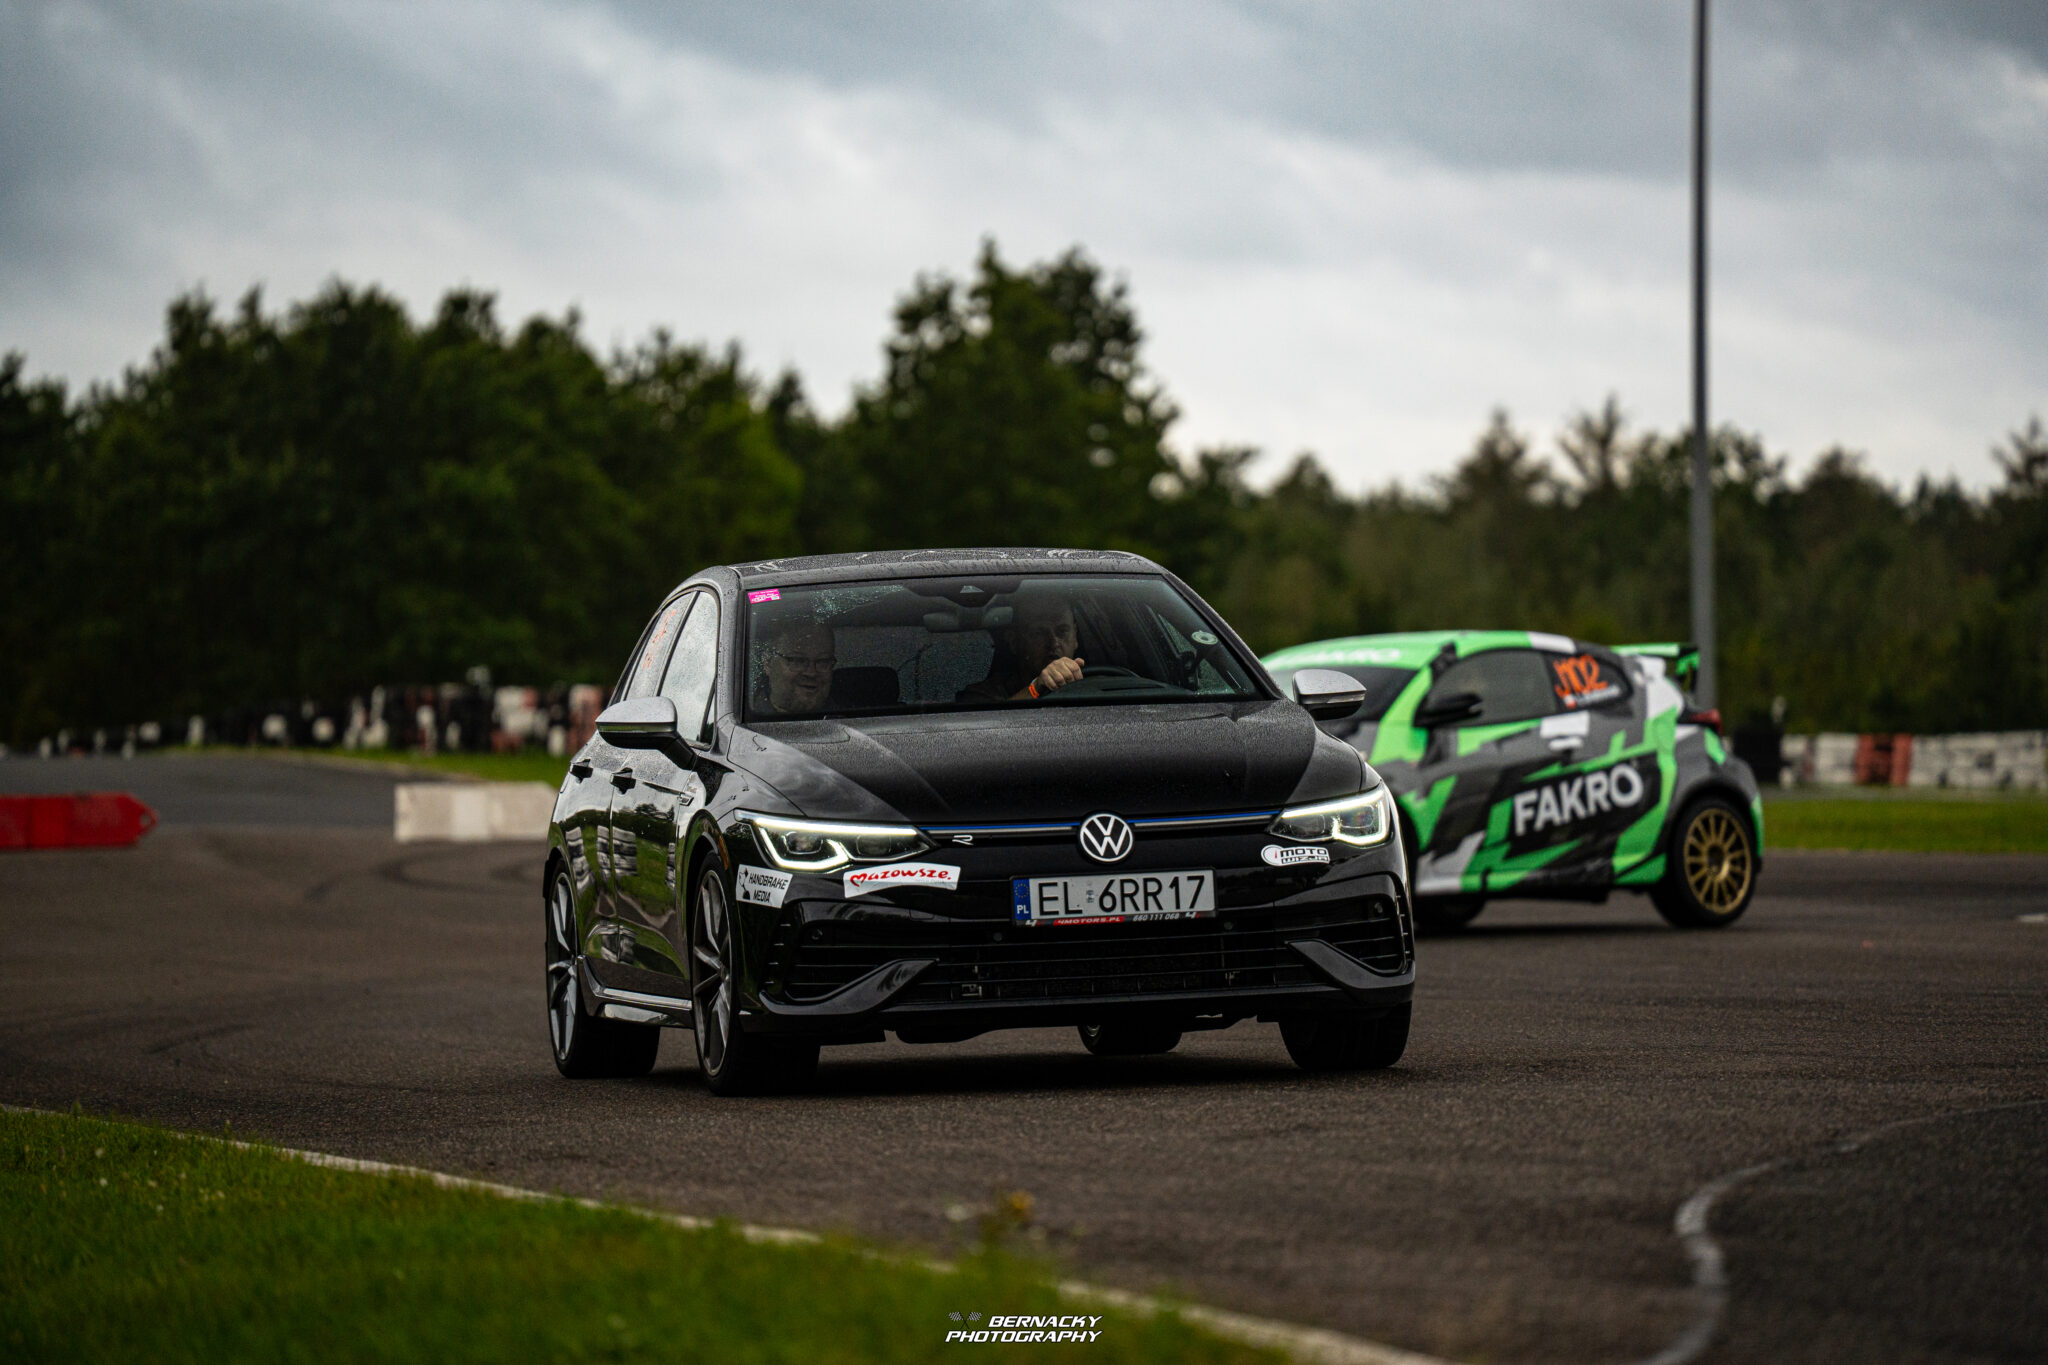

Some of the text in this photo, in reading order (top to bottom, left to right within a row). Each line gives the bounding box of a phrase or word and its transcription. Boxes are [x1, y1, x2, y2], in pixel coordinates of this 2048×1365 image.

[1513, 763, 1644, 836] FAKRO
[1280, 848, 1327, 858] MOTO
[748, 873, 788, 890] HANDBRAKE
[753, 889, 771, 902] MEDIA
[1038, 875, 1205, 915] EL 6RR17
[1016, 904, 1029, 914] PL
[1057, 916, 1121, 925] 4MOTORS.PL
